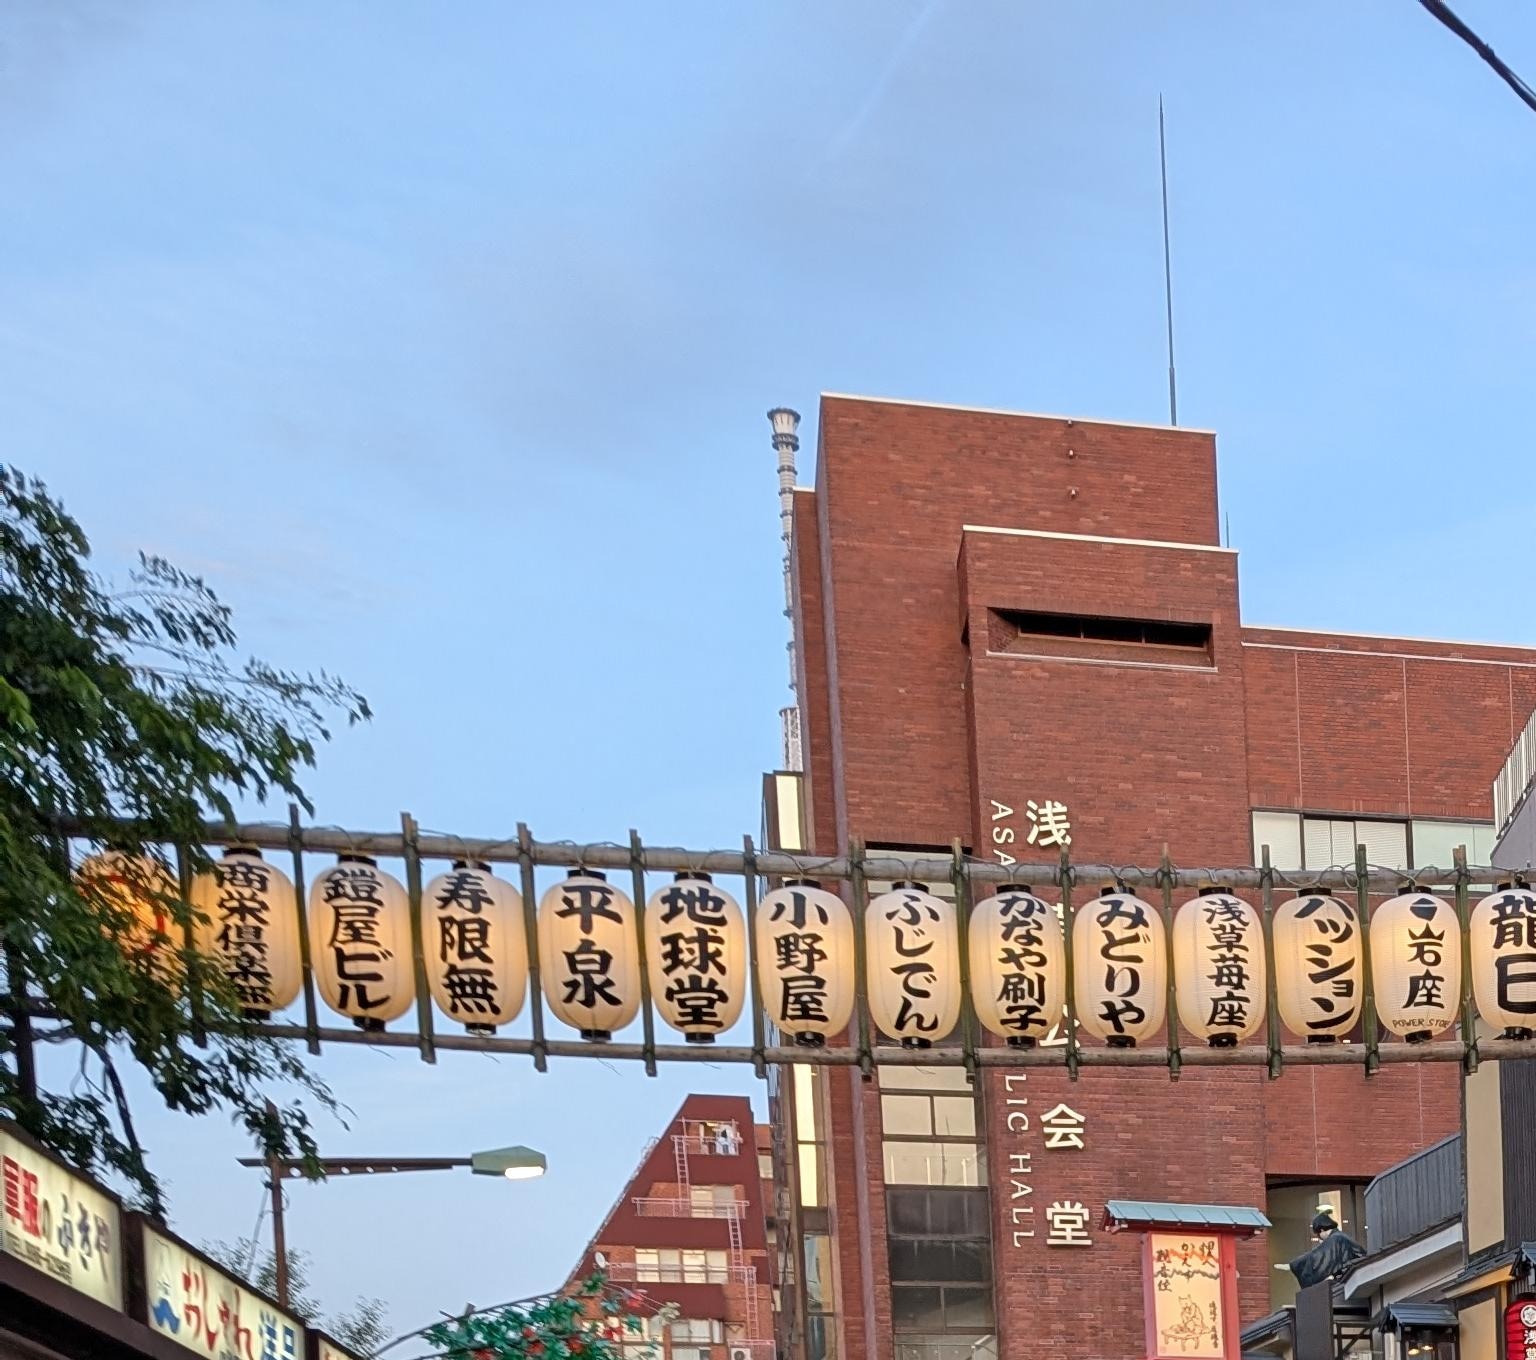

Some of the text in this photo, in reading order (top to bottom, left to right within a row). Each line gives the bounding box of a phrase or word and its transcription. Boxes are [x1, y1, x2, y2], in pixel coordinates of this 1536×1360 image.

[322, 868, 394, 1010] 鎧屋ビル
[435, 872, 502, 1016] 寿限無
[554, 884, 635, 1008] 平泉
[658, 884, 729, 1030] 地球堂
[770, 891, 830, 1024] 小野屋
[998, 896, 1049, 1030] かなや刷子
[1095, 899, 1150, 1025] みどりや
[1202, 900, 1250, 1028] 浅草苺座
[1402, 922, 1445, 1009] 岩座
